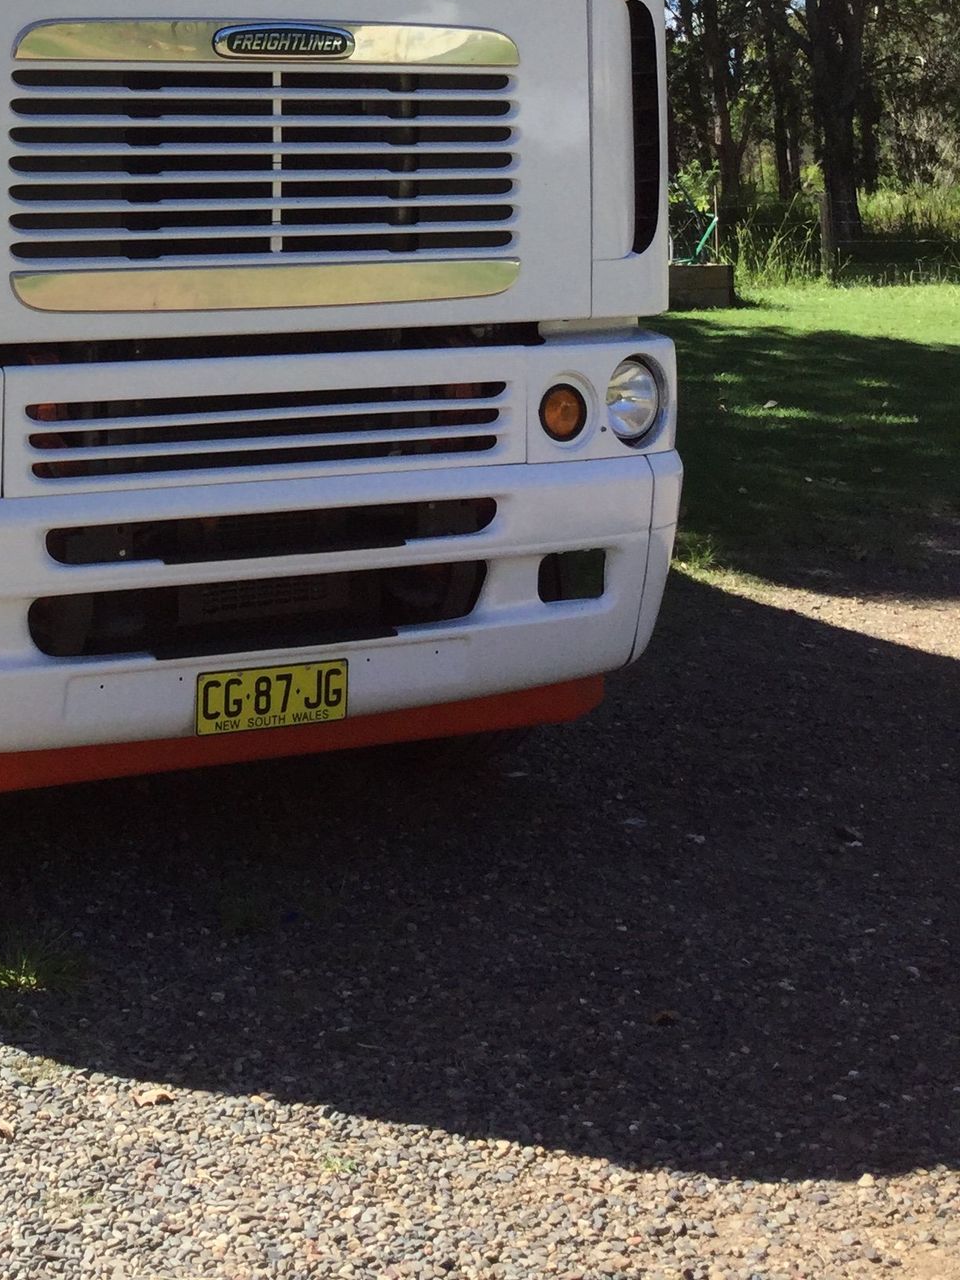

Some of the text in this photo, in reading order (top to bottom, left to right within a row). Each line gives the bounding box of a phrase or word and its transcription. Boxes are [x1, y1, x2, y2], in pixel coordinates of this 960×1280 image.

[232, 33, 342, 51] FREIGHTLINER
[214, 709, 329, 731] NEW SOUTH WALES
